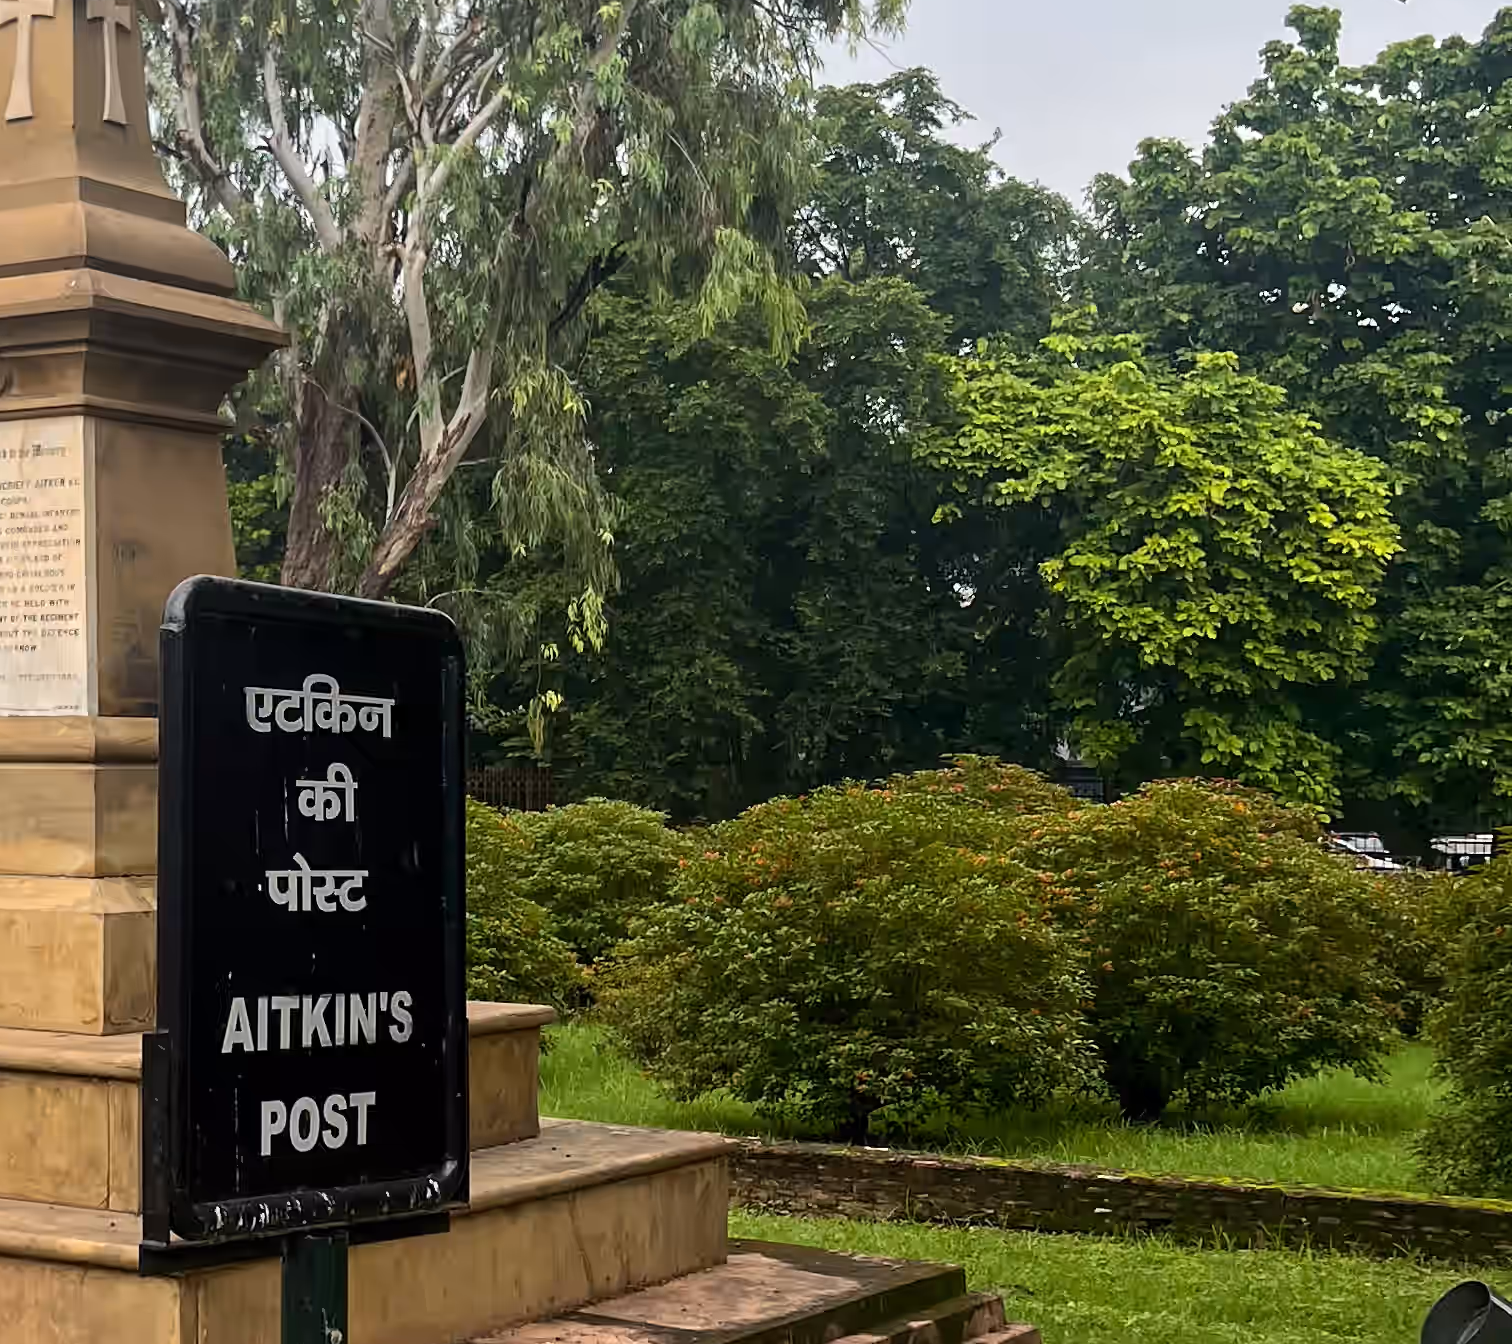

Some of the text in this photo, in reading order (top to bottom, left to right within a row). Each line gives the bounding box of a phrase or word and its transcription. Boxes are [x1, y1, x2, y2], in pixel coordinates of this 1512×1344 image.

[243, 673, 396, 738] एटकिन
[296, 763, 359, 822] की
[265, 852, 369, 913] पोस्ट
[221, 990, 413, 1054] AITKIN'S
[260, 1092, 376, 1156] POST
